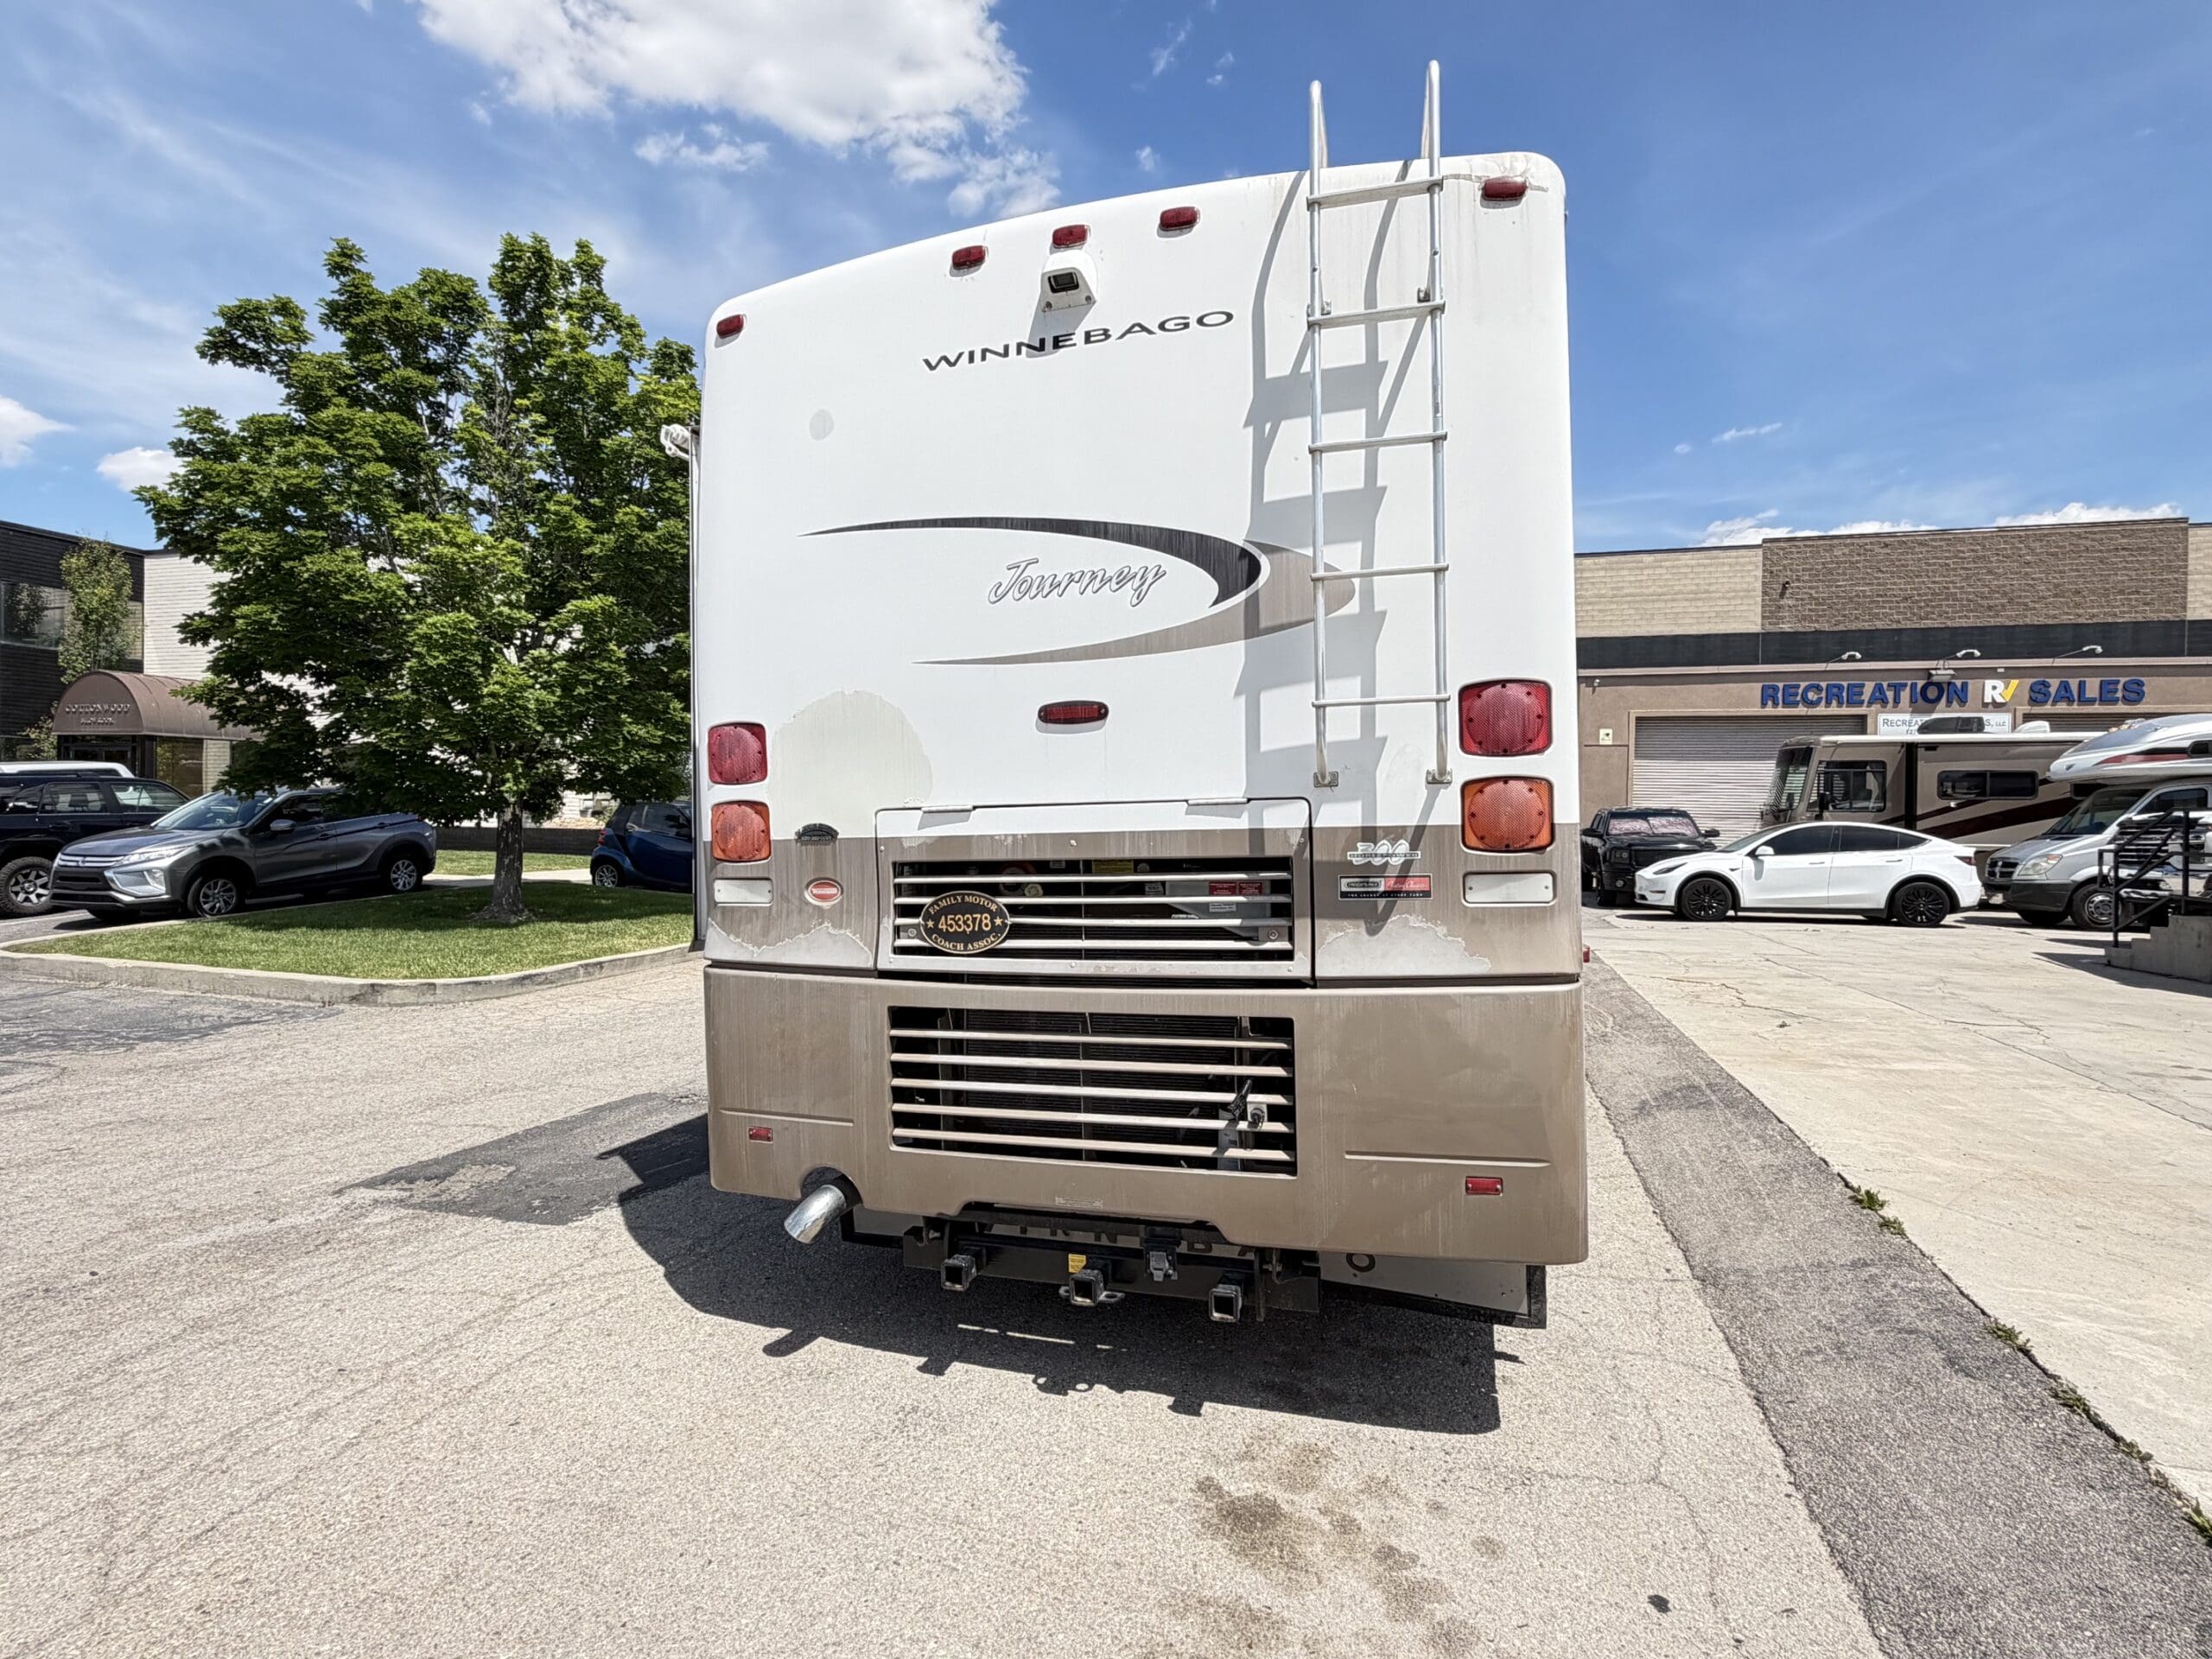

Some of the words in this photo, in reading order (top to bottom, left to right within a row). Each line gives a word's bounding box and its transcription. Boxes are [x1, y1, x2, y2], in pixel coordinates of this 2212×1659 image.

[922, 311, 1235, 372] WINNEBAGO
[988, 557, 1167, 607] Journey
[1760, 681, 1969, 706] RECREATION
[1983, 679, 2019, 703] RV
[2029, 678, 2146, 704] SALES
[65, 703, 130, 714] COTTONWOOD
[1351, 839, 1410, 865] 300
[928, 895, 963, 914] FAMILY
[963, 894, 998, 912] MOTOR
[938, 913, 992, 933] 453378
[931, 933, 964, 950] COACH
[967, 932, 1001, 950] ASSOC.
